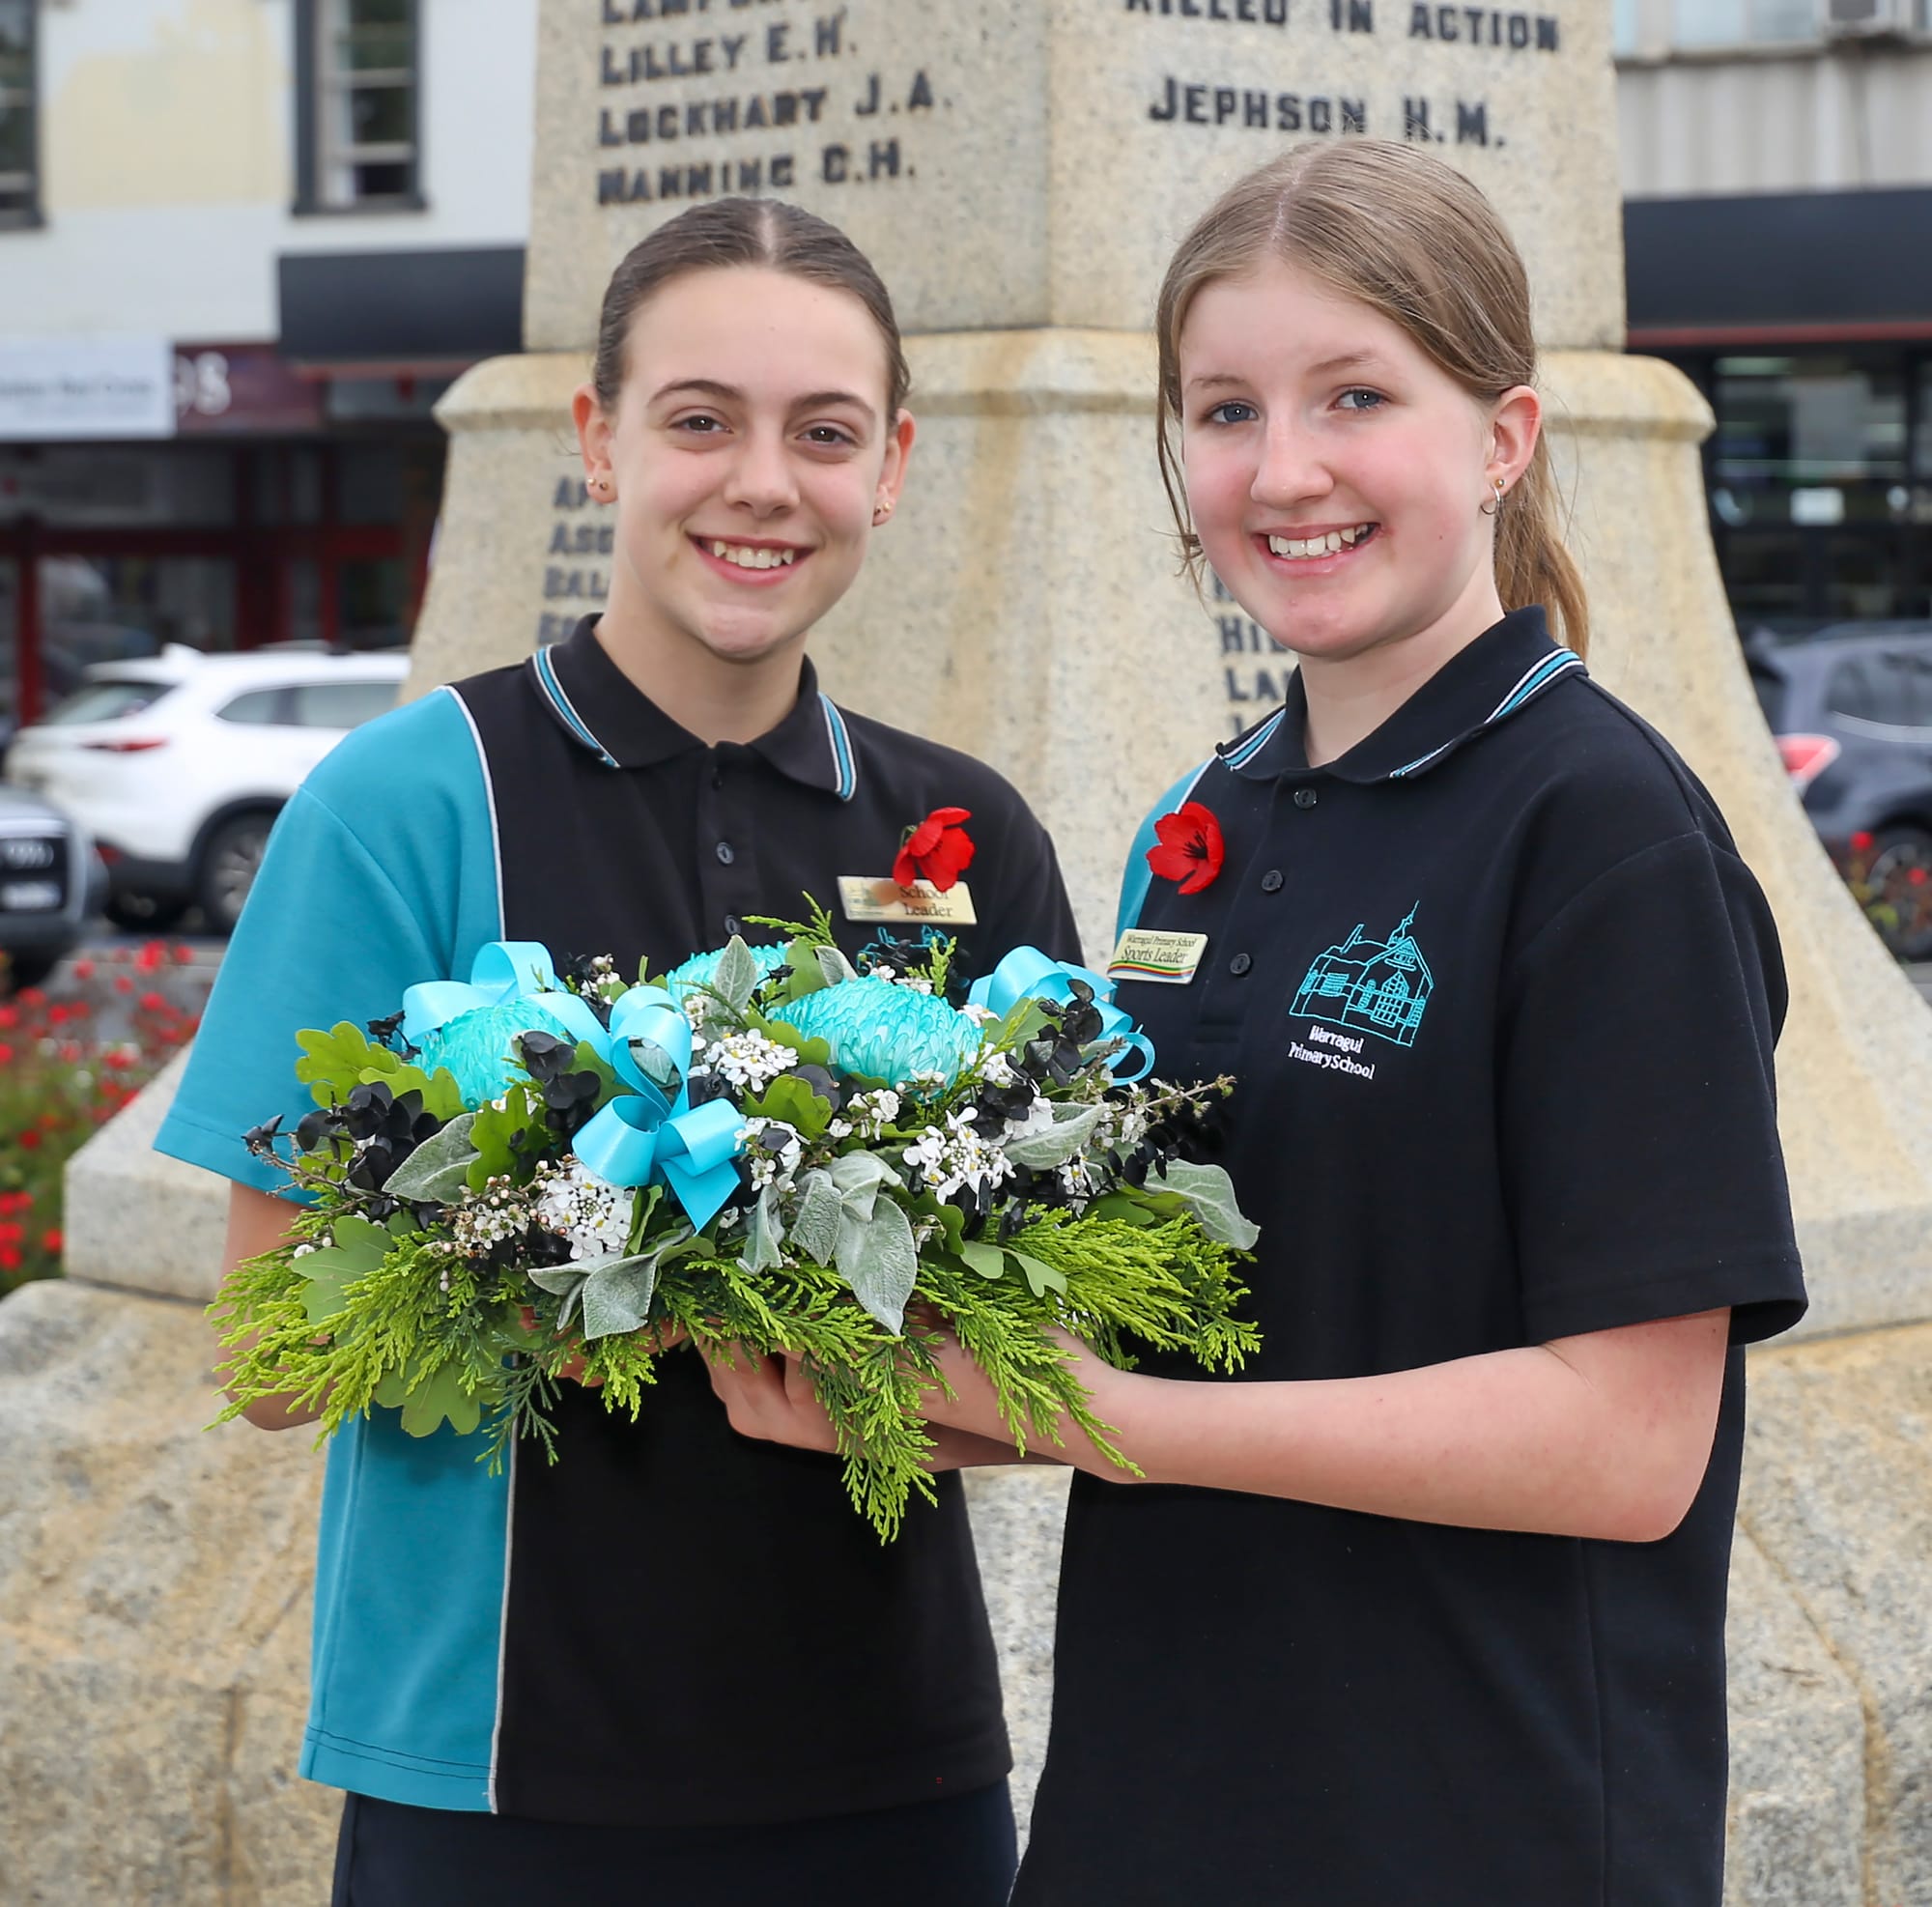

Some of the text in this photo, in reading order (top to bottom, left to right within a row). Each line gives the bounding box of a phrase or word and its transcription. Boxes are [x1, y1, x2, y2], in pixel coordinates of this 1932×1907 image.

[1330, 0, 1373, 34] IN
[1409, 3, 1560, 51] ACTION
[601, 35, 747, 85] LILLEY
[599, 87, 828, 147] LOCKHART
[1149, 76, 1366, 133] JEPHSON
[598, 154, 795, 206] MANNING
[905, 902, 952, 917] Leader
[1121, 946, 1188, 963] Sports Leader
[1176, 937, 1197, 948] School
